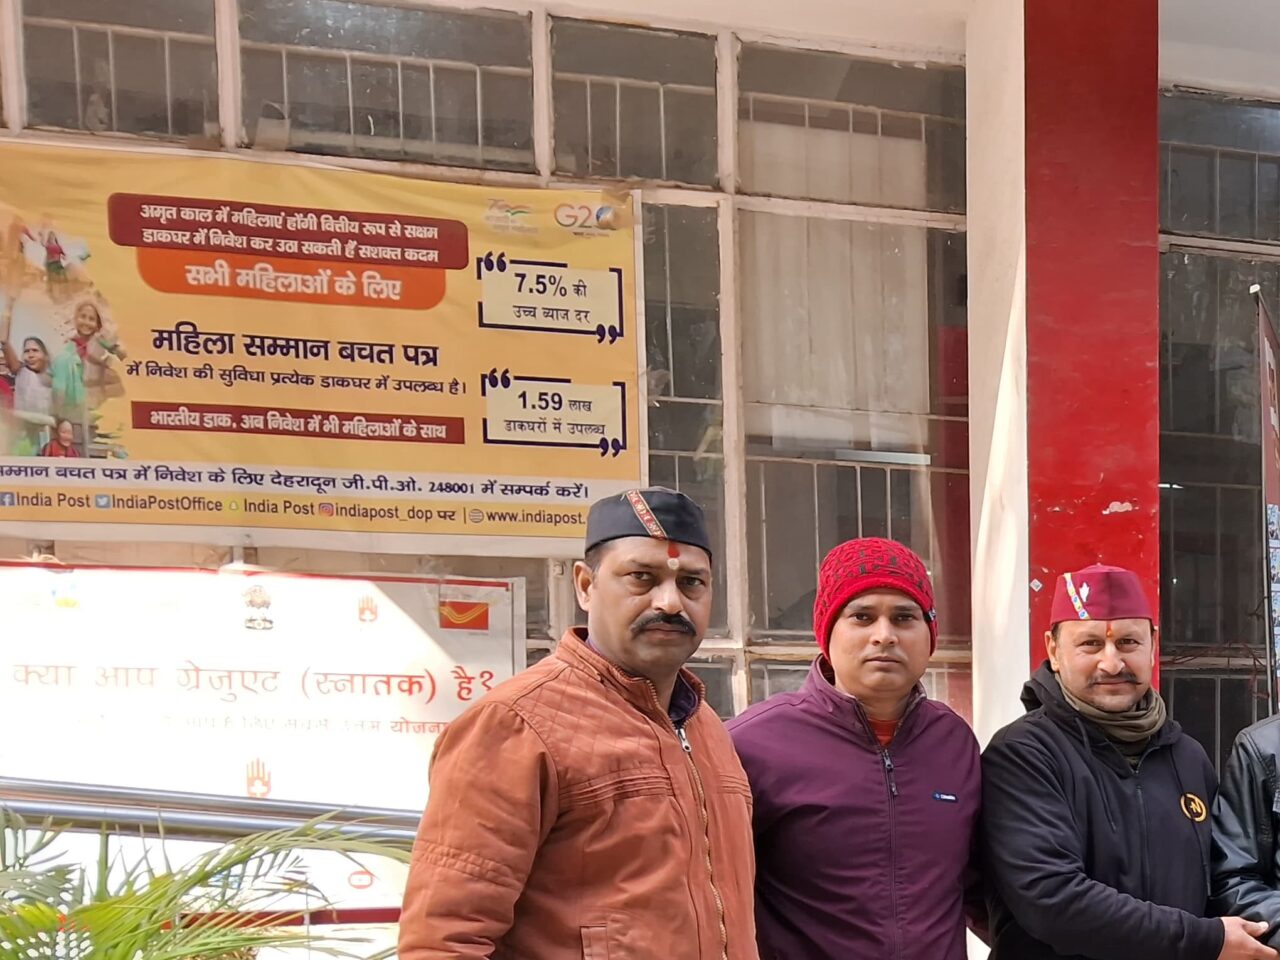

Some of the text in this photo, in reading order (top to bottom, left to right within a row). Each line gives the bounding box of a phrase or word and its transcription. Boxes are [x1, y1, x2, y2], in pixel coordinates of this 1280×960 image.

[140, 204, 439, 240] अमृत काल में महिलाएं होंगी वित्तीय रूप से सक्षम
[142, 227, 439, 263] डाकघर में निवेश कर उठा सकती हैं सशक्त कदम
[185, 259, 402, 300] सभी महिलाओं के लिए
[514, 272, 587, 297] 7.5% की
[513, 305, 538, 320] उच्च
[575, 309, 591, 324] दर
[151, 321, 439, 367] महिला सम्मान बचत पत्र
[126, 361, 142, 377] में
[146, 361, 188, 379] निवेश
[193, 362, 214, 380] की
[218, 365, 266, 387] सुविधा
[270, 369, 315, 386] प्रत्येक
[320, 375, 371, 390] डाकघर
[375, 375, 390, 391] में
[393, 380, 444, 394] उपलब्ध
[518, 391, 593, 412] 1.59 लाख
[150, 406, 200, 426] भारतीय
[241, 415, 264, 430] अब
[267, 411, 304, 431] निवेश
[308, 414, 322, 433] में
[323, 415, 339, 434] भी
[342, 415, 401, 437] महिलाओं
[403, 420, 417, 438] के
[419, 424, 447, 439] साथ
[504, 417, 606, 435] डाकघरों में उपलब्ध
[55, 466, 96, 480] बचत
[102, 468, 128, 481] पत्र
[134, 465, 152, 482] में
[155, 465, 202, 483] निवेश
[208, 467, 227, 483] के
[232, 467, 265, 487] लिए
[270, 470, 337, 494] देहरादून
[428, 482, 475, 495] 248001
[482, 479, 498, 495] में
[501, 481, 551, 498] सम्पर्क
[16, 491, 52, 507] India
[57, 492, 91, 508] Post
[111, 494, 223, 512] IndiaPostOffice
[244, 498, 279, 514] India
[283, 500, 315, 516] Post
[336, 503, 433, 523] indiapost_dop
[437, 510, 457, 521] पर
[13, 665, 77, 686] क्या
[96, 666, 160, 688] आप
[176, 660, 280, 702] ग्रेजुएट
[301, 668, 437, 704] (स्नातक)
